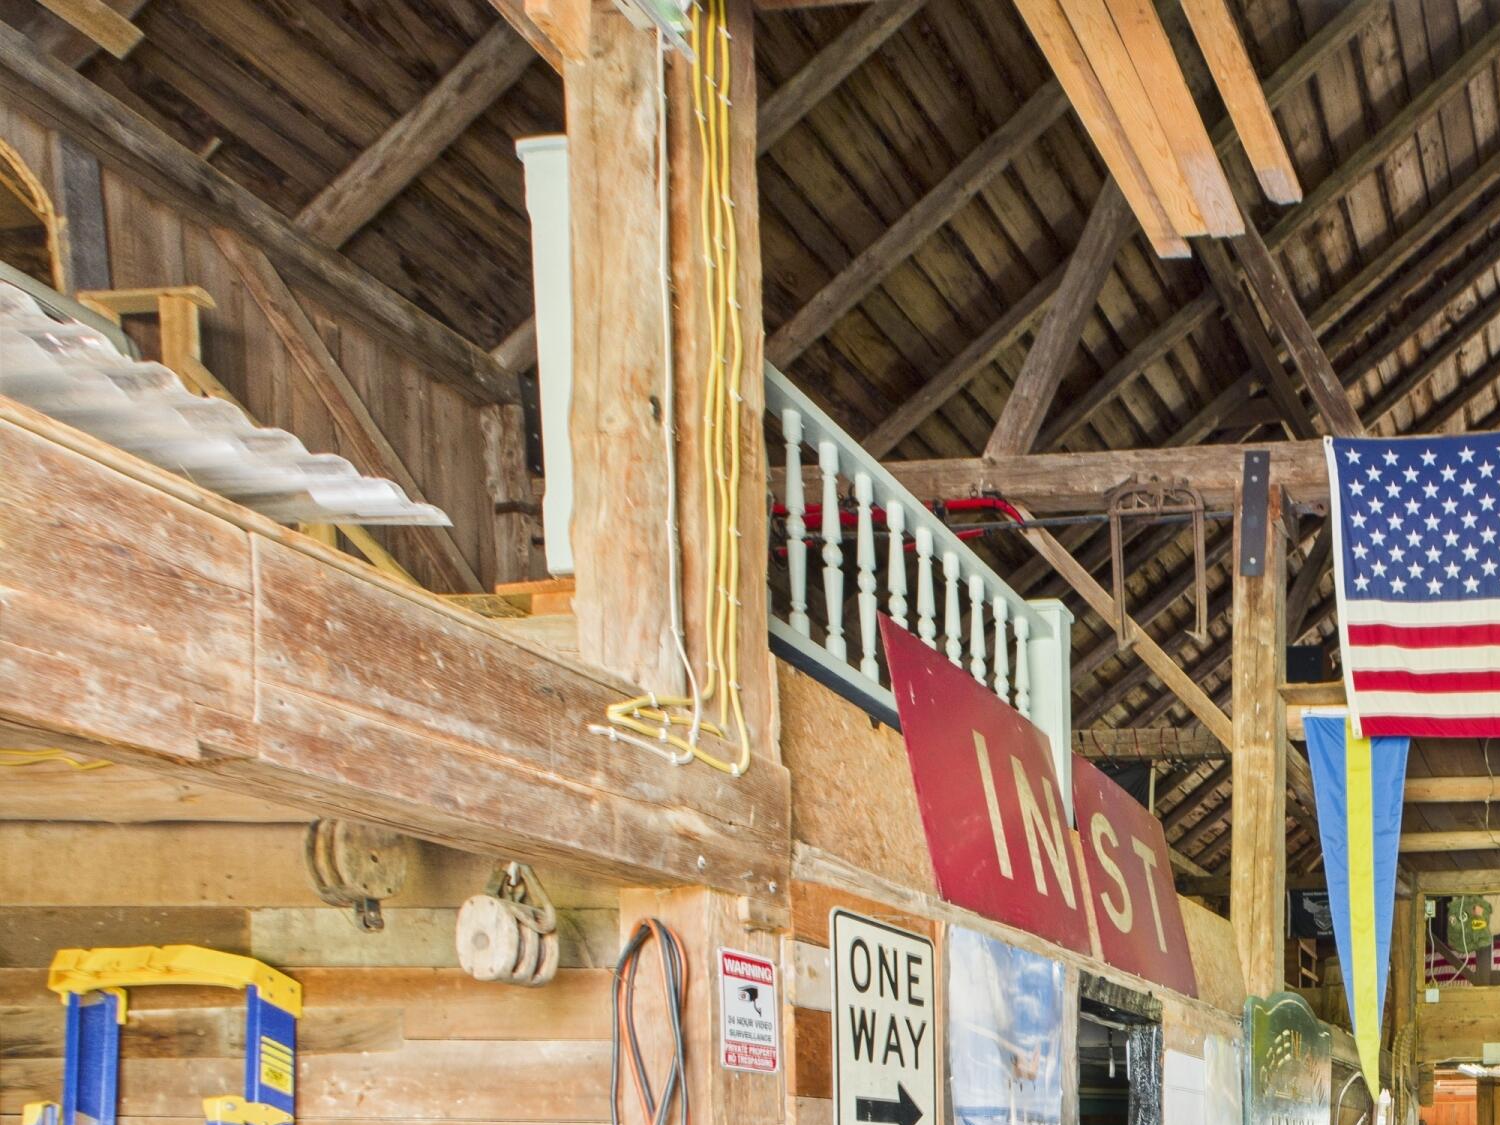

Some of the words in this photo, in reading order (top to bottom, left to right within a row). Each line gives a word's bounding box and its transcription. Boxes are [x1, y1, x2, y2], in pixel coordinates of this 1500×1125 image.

[725, 959, 772, 982] WARNING
[850, 936, 924, 1006] ONE
[729, 1028, 772, 1043] SURVEILLANCE
[736, 1017, 754, 1028] HOUR
[754, 1021, 773, 1031] VIDEO
[850, 1004, 927, 1070] WAY
